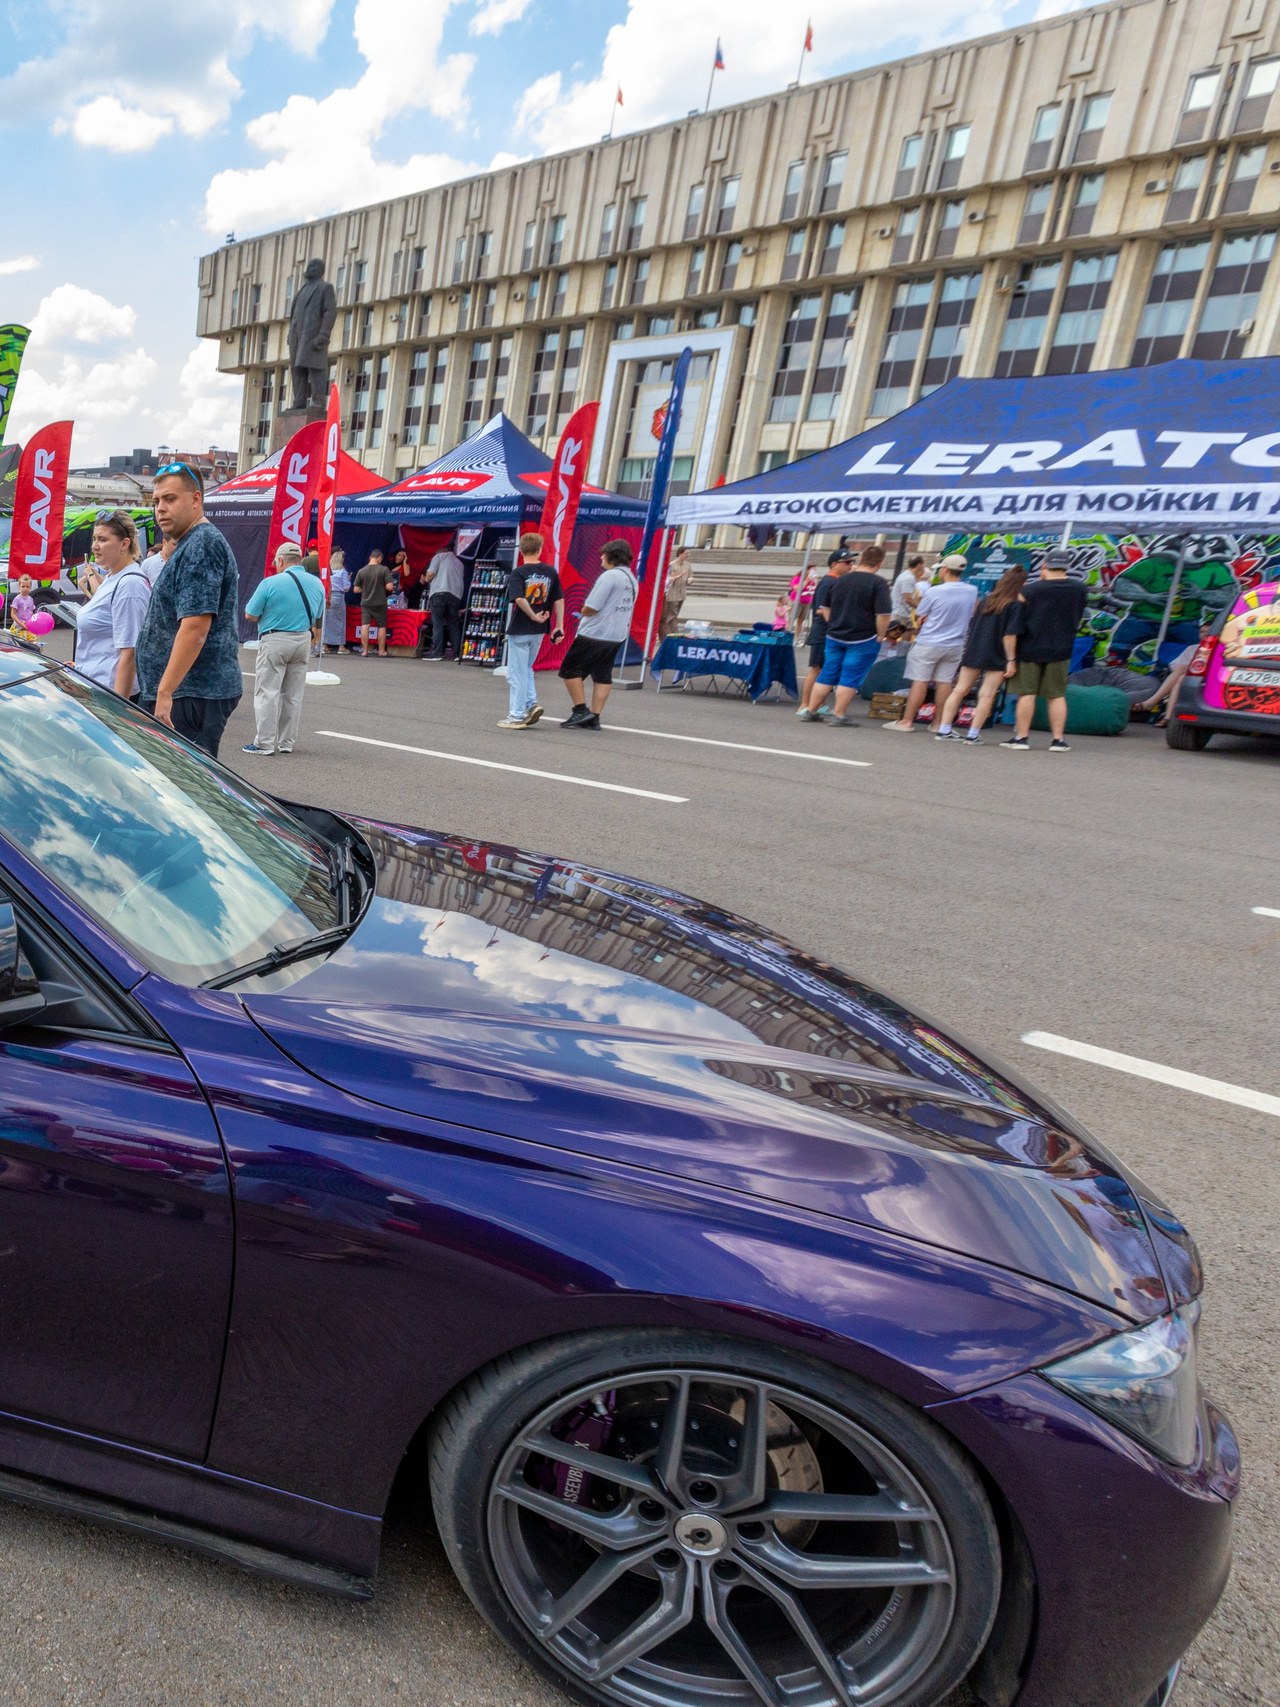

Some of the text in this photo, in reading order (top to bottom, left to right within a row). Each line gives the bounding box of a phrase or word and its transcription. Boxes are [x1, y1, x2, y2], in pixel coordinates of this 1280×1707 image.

[407, 477, 471, 488] LAVR
[24, 448, 56, 565] LAVR
[282, 452, 310, 545] AVR
[347, 506, 385, 514] АВТОКОСМЕТИКА
[386, 506, 427, 514] АВТОХИМИЯ
[472, 504, 520, 513] АВТОХИМИЯ
[735, 494, 984, 516] АВТОКОСМЕТИКА
[992, 493, 1069, 515] ДЛЯ
[1076, 488, 1220, 512] МОЙКИ
[1229, 491, 1262, 512] И
[677, 646, 753, 666] LERATON
